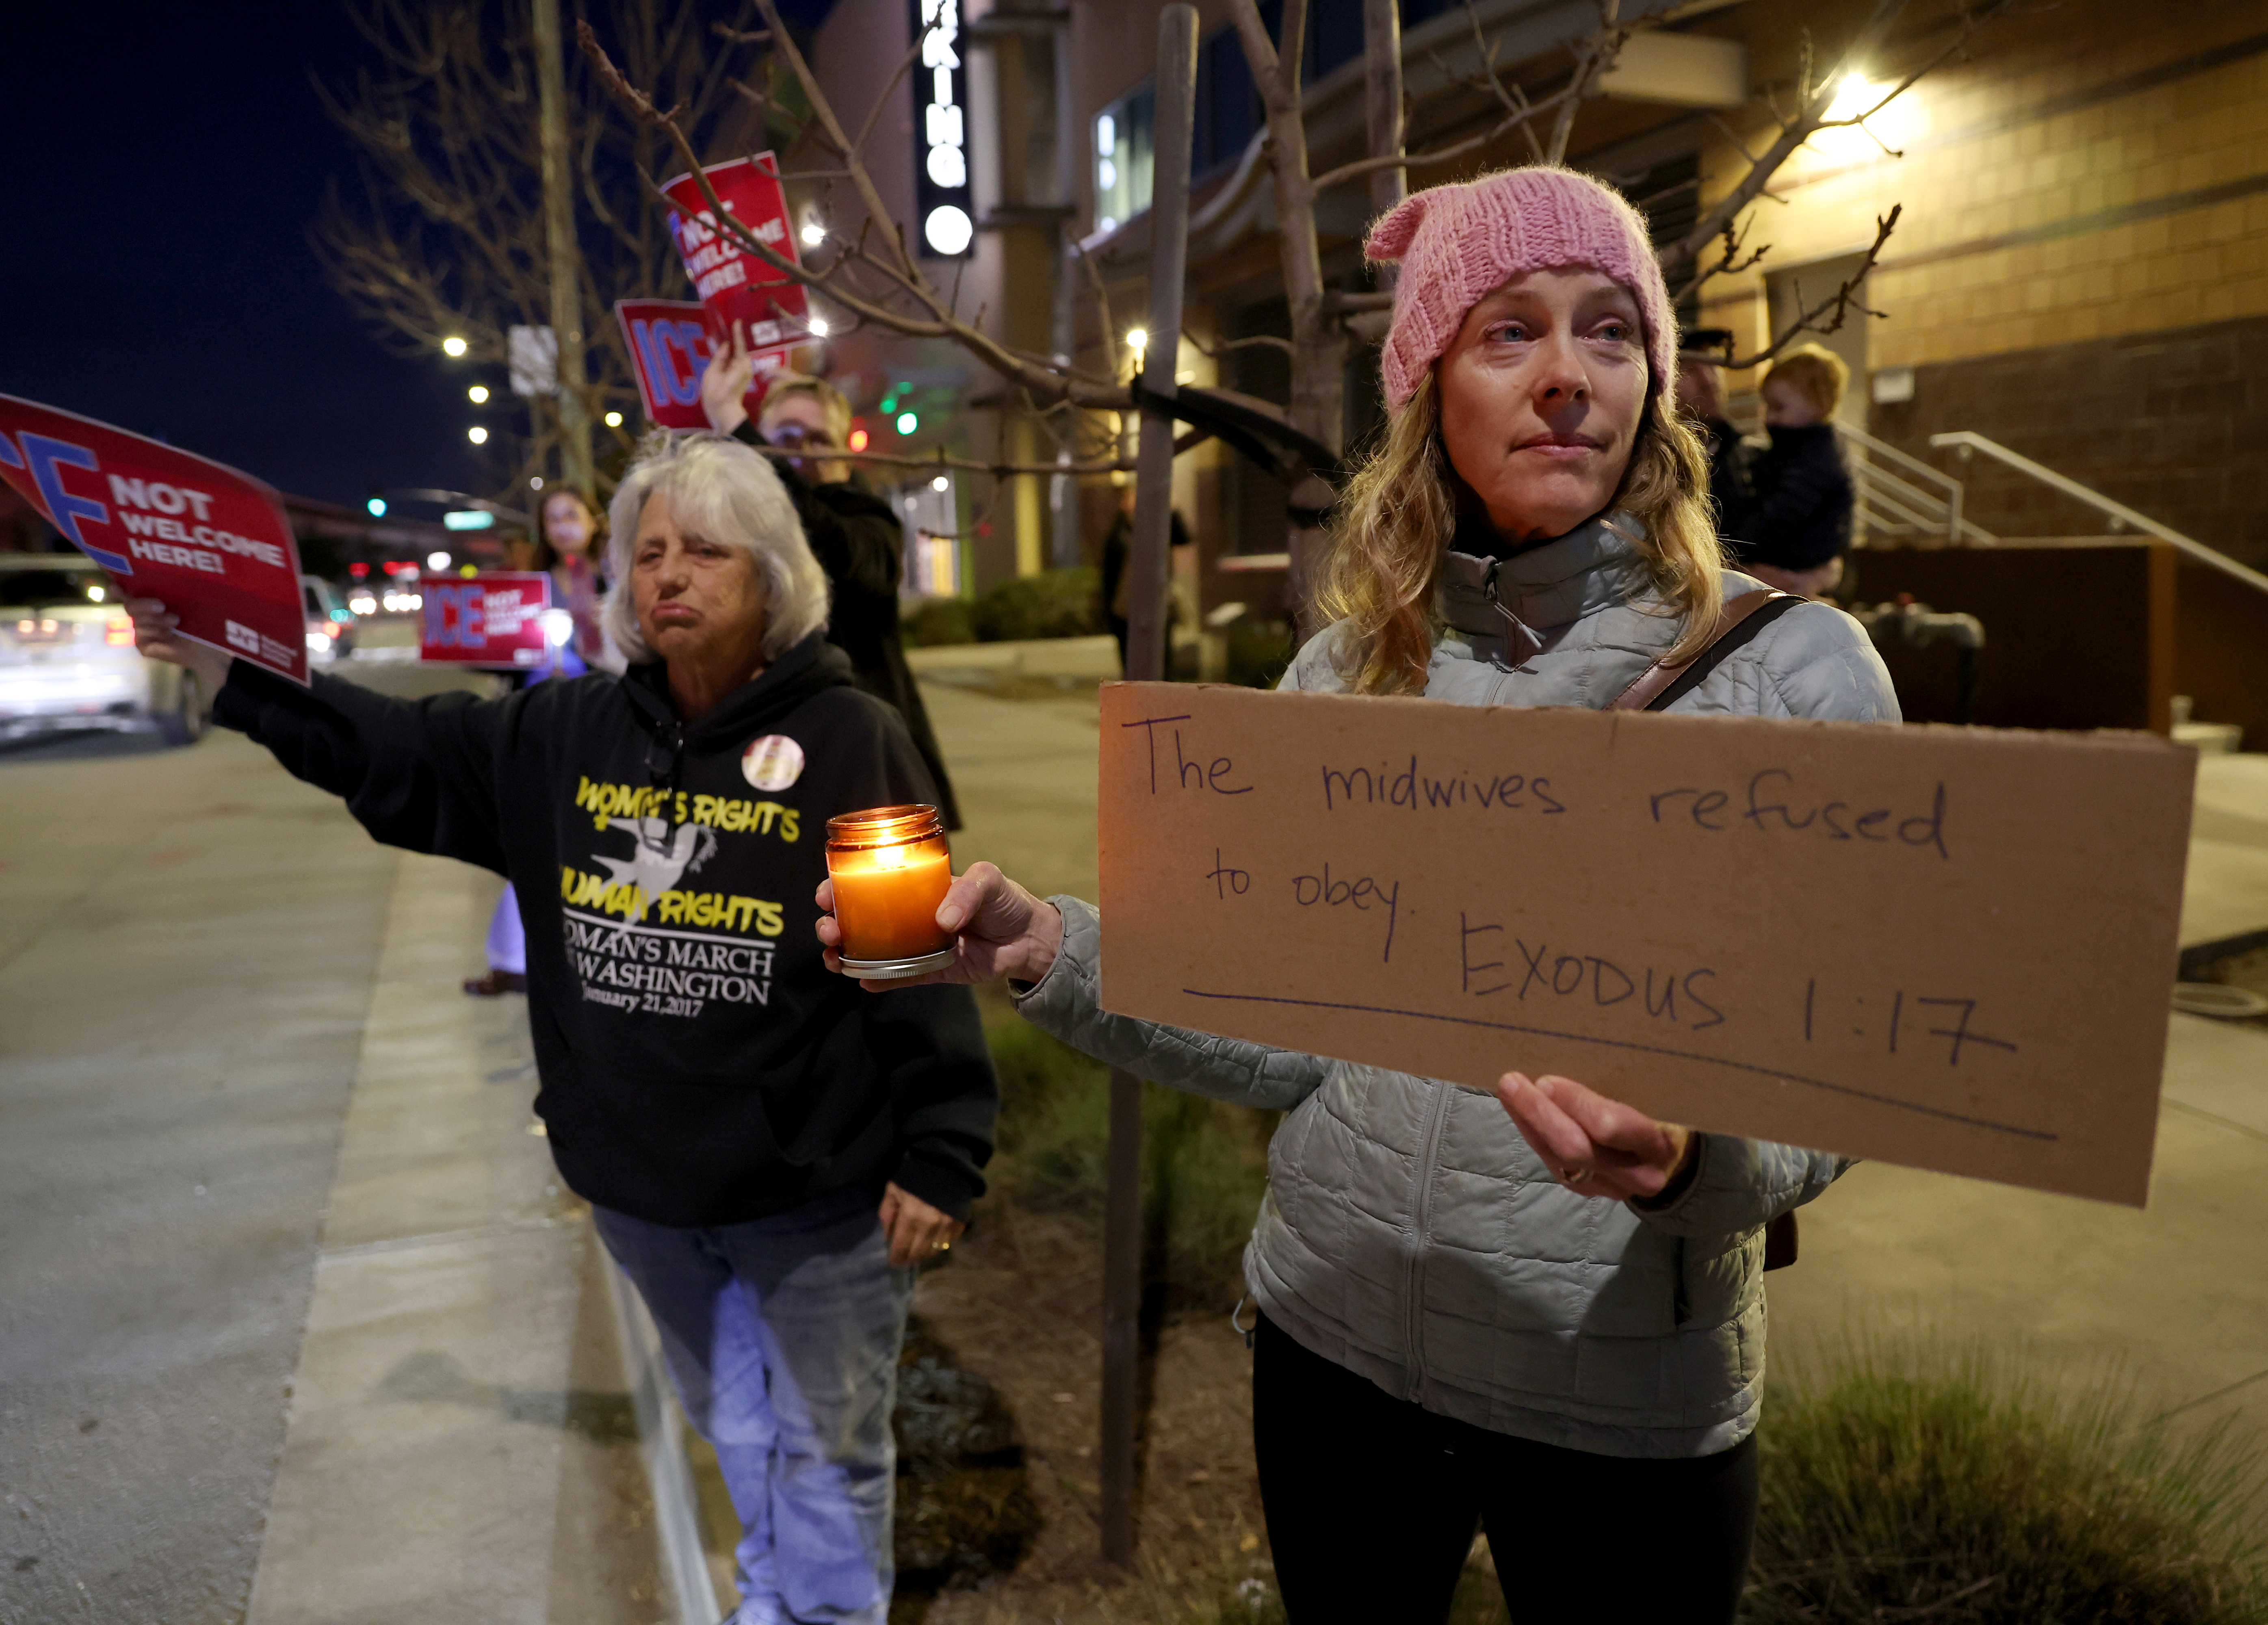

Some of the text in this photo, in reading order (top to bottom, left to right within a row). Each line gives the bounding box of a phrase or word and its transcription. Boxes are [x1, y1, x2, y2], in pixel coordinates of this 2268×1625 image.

[107, 474, 213, 520] NOT
[119, 511, 286, 568] WELCOME
[127, 538, 225, 574] HERE!
[424, 585, 486, 646] ICE
[1122, 715, 1253, 794] The
[1651, 768, 1948, 860] refused
[693, 794, 800, 843] RIGHTS
[560, 864, 784, 936] UMAN RIGHTS
[1207, 847, 1250, 899] to
[563, 919, 661, 962] OMAN'S
[666, 940, 774, 975] MARCH
[577, 951, 772, 1006] WASHINGTON
[1805, 978, 2018, 1066] 1:17
